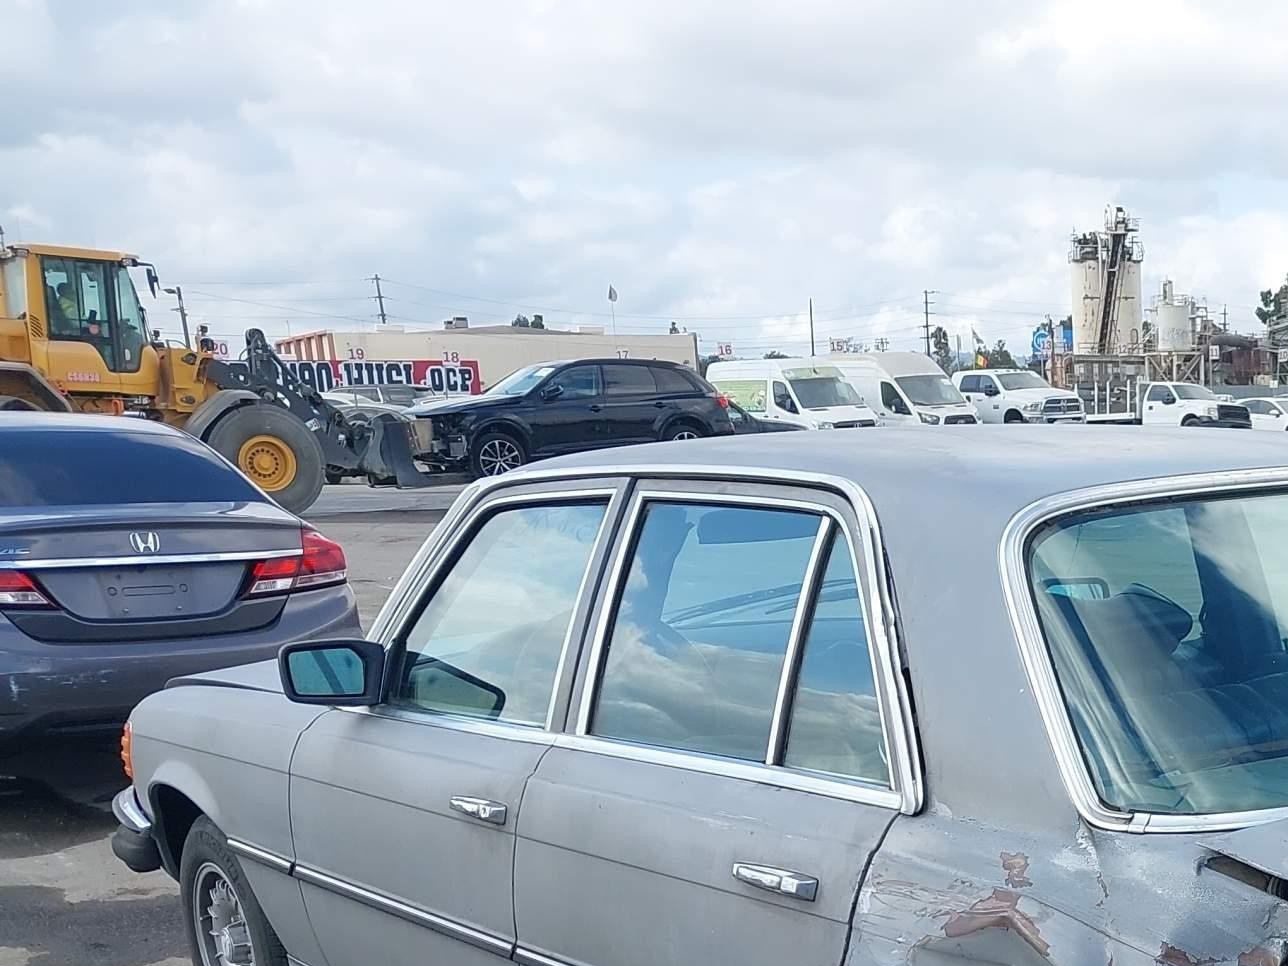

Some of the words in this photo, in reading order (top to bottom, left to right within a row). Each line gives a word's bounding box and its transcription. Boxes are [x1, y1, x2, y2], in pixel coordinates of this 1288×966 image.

[718, 344, 732, 355] 16
[830, 341, 843, 351] 15
[348, 348, 364, 360] 19
[443, 351, 460, 363] 18
[616, 350, 629, 359] 17
